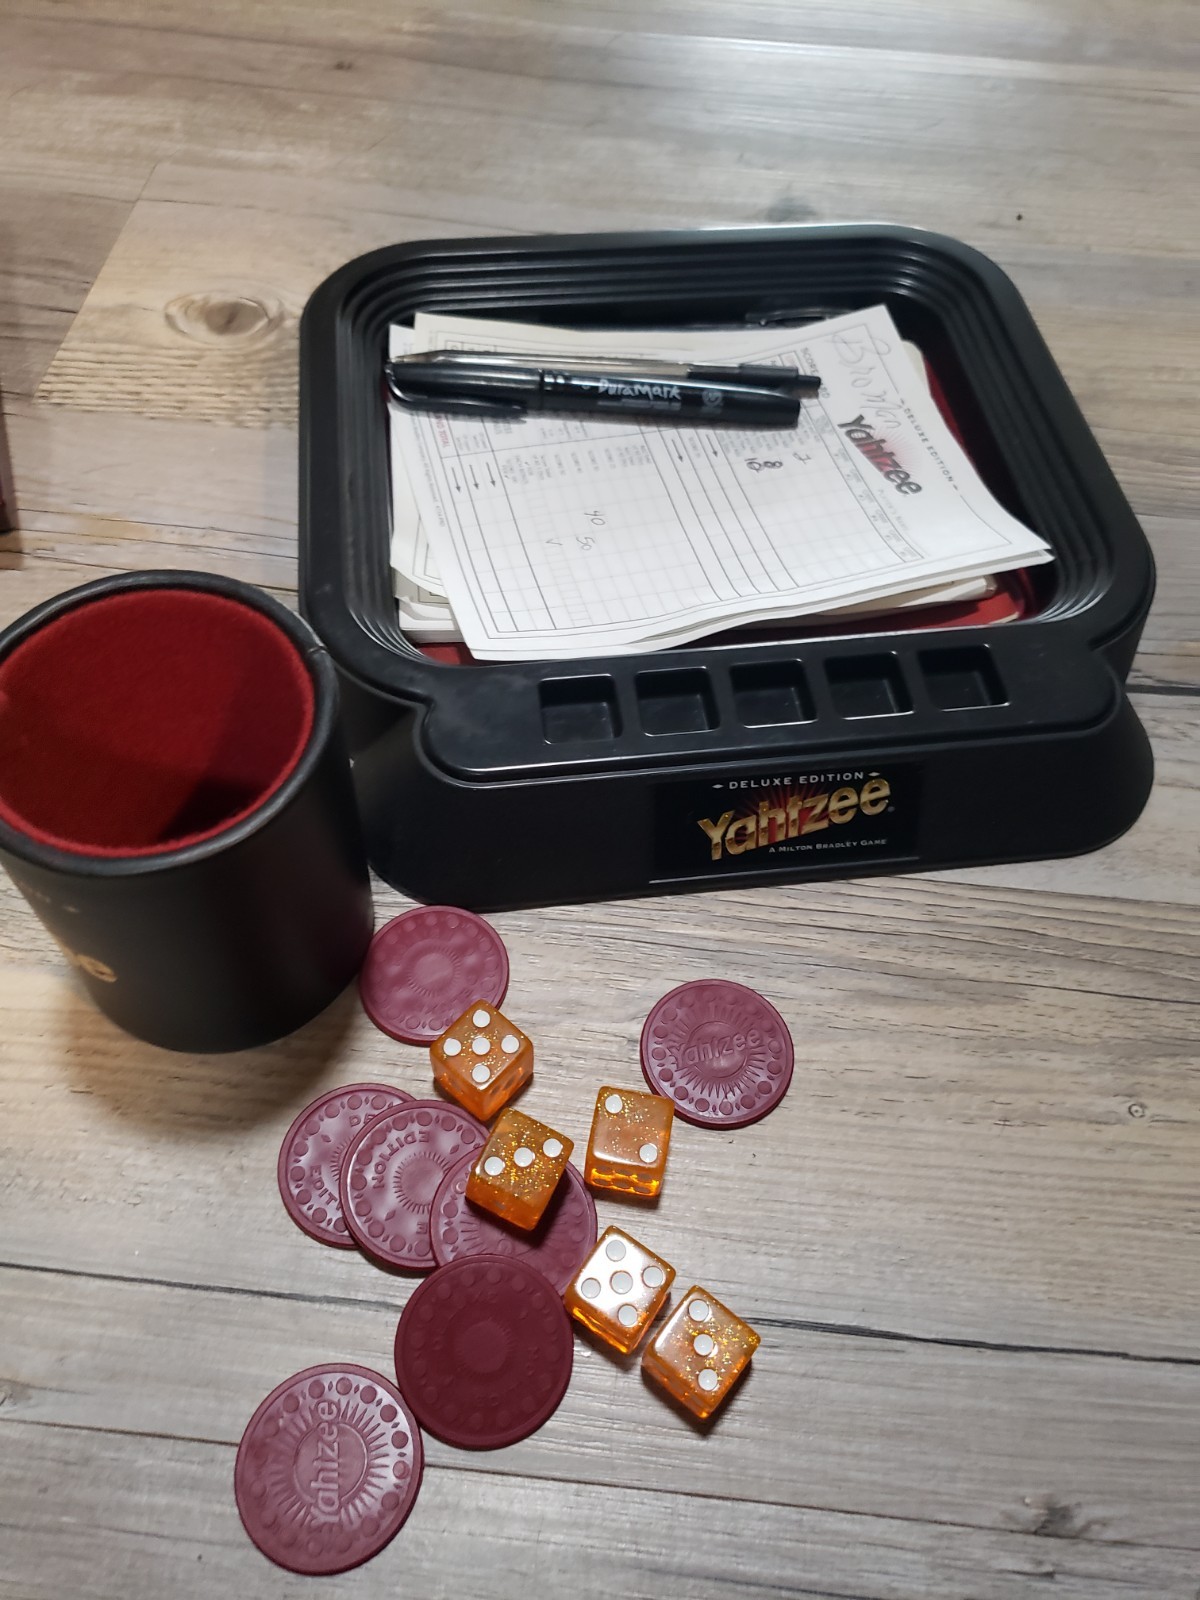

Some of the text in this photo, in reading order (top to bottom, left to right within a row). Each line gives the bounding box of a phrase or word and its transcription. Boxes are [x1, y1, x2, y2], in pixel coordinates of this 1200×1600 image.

[837, 414, 923, 495] Yahtzee
[904, 407, 954, 482] DELUXE EDITION
[729, 771, 864, 790] DELUXE EDITION
[697, 778, 891, 861] Yahtzee
[667, 1029, 764, 1070] Yahtzee
[309, 1164, 341, 1212] EDIT
[372, 1130, 430, 1190] EDITION
[311, 1398, 340, 1526] Yahtzee
